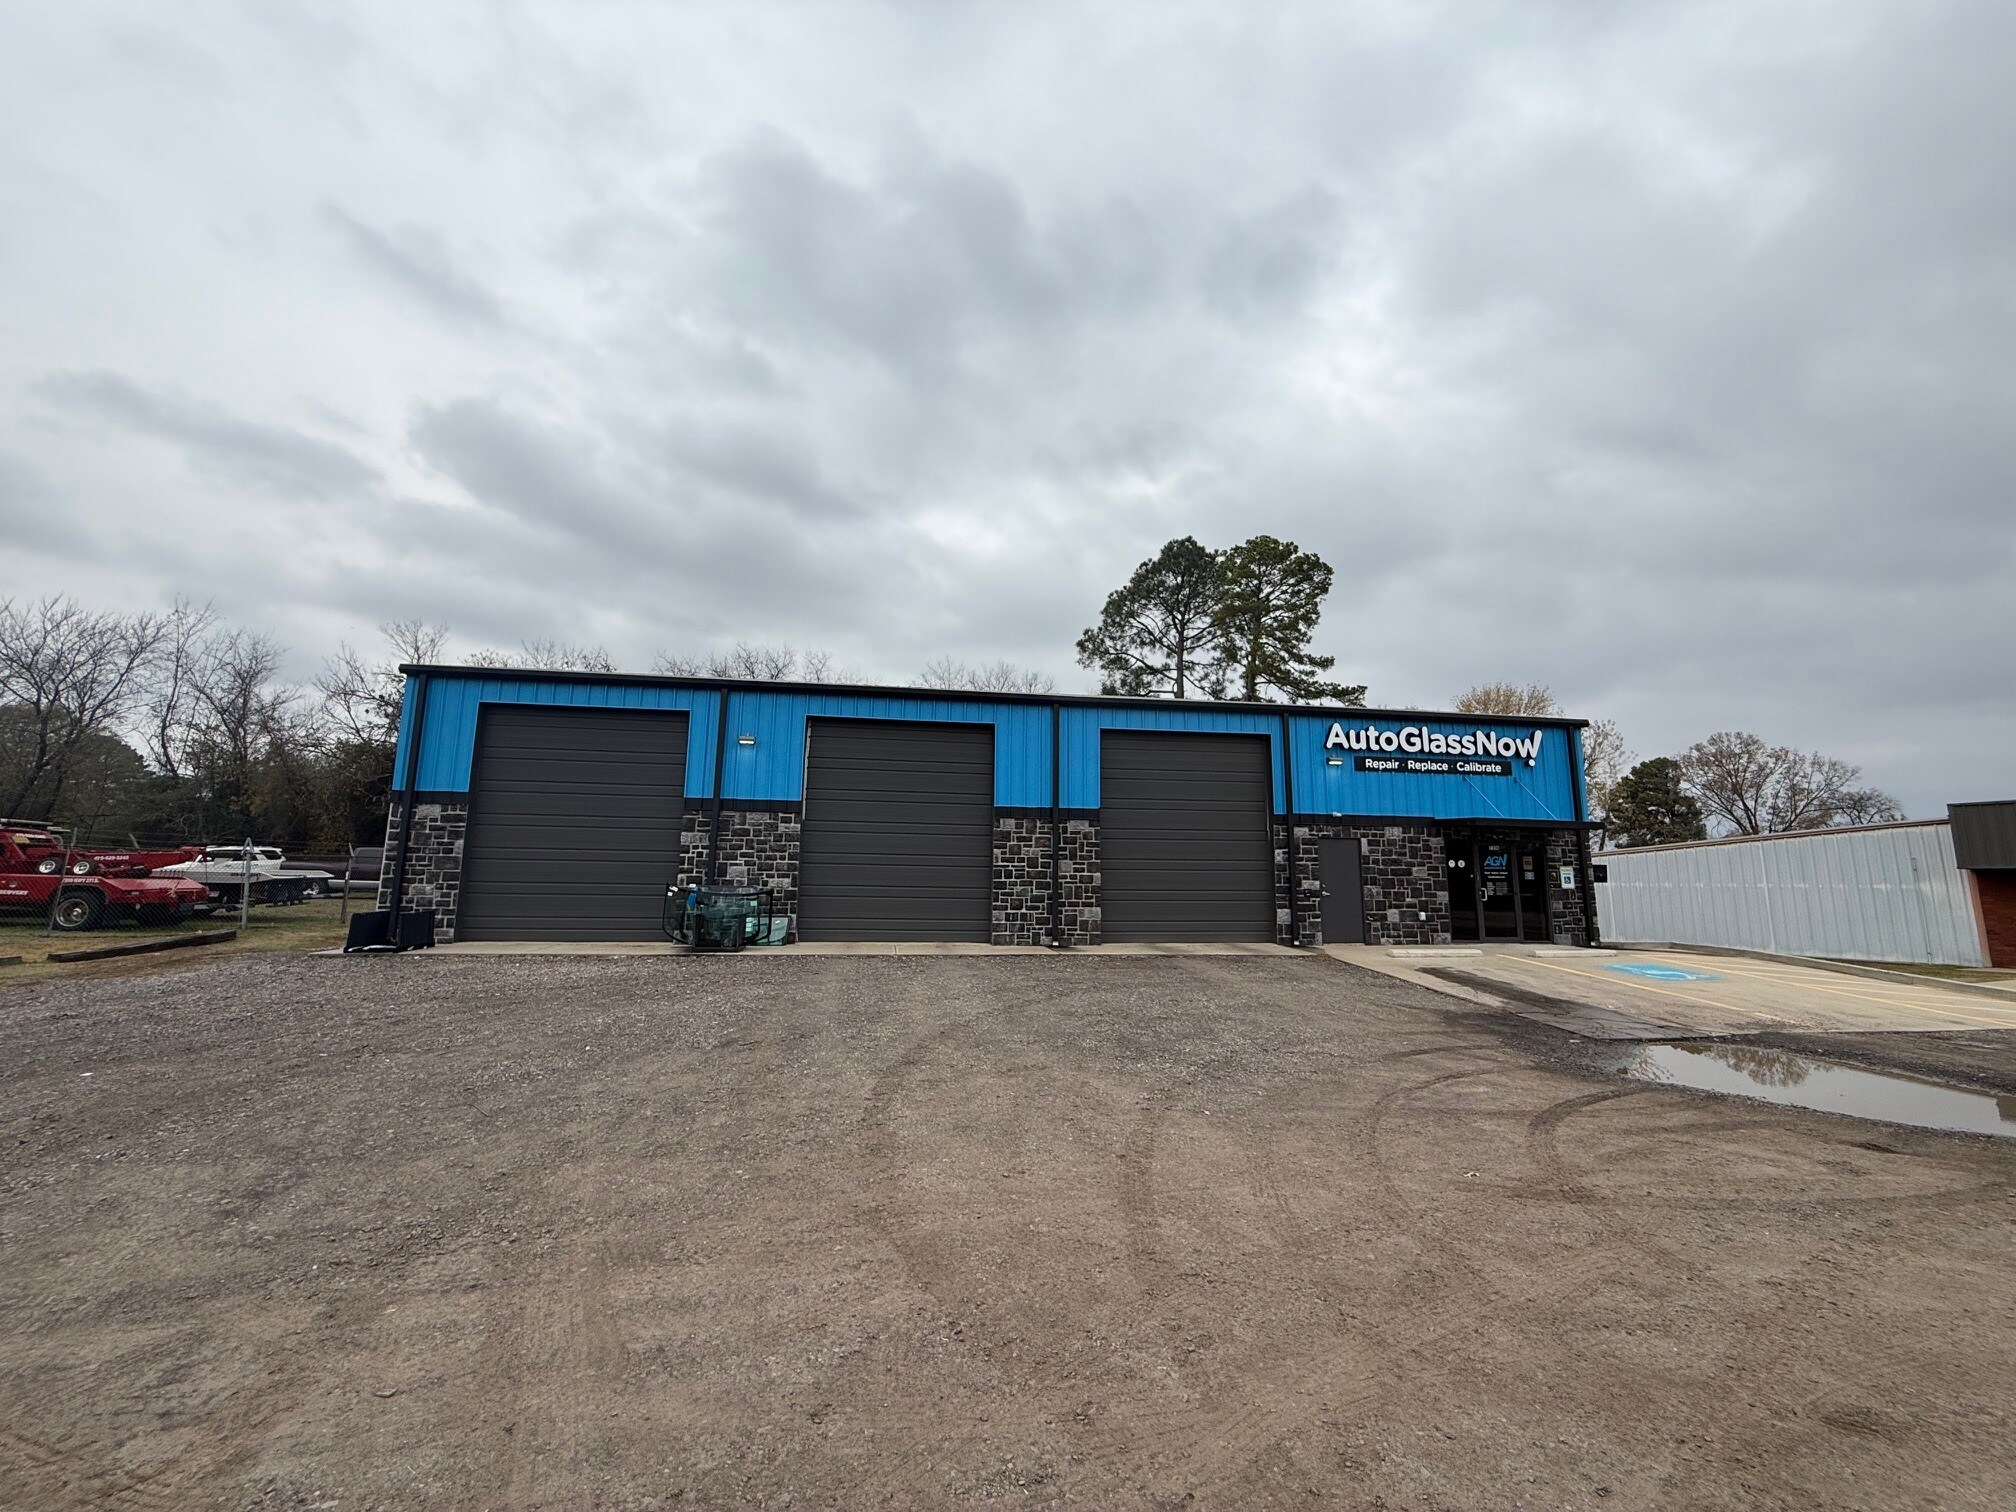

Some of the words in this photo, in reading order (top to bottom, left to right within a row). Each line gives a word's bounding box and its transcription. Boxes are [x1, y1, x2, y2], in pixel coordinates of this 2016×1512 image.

[1326, 722, 1543, 767] AutoGlassNow!
[1365, 758, 1400, 770] Repair
[1407, 760, 1449, 772] Replace
[1456, 761, 1502, 773] Calibrate
